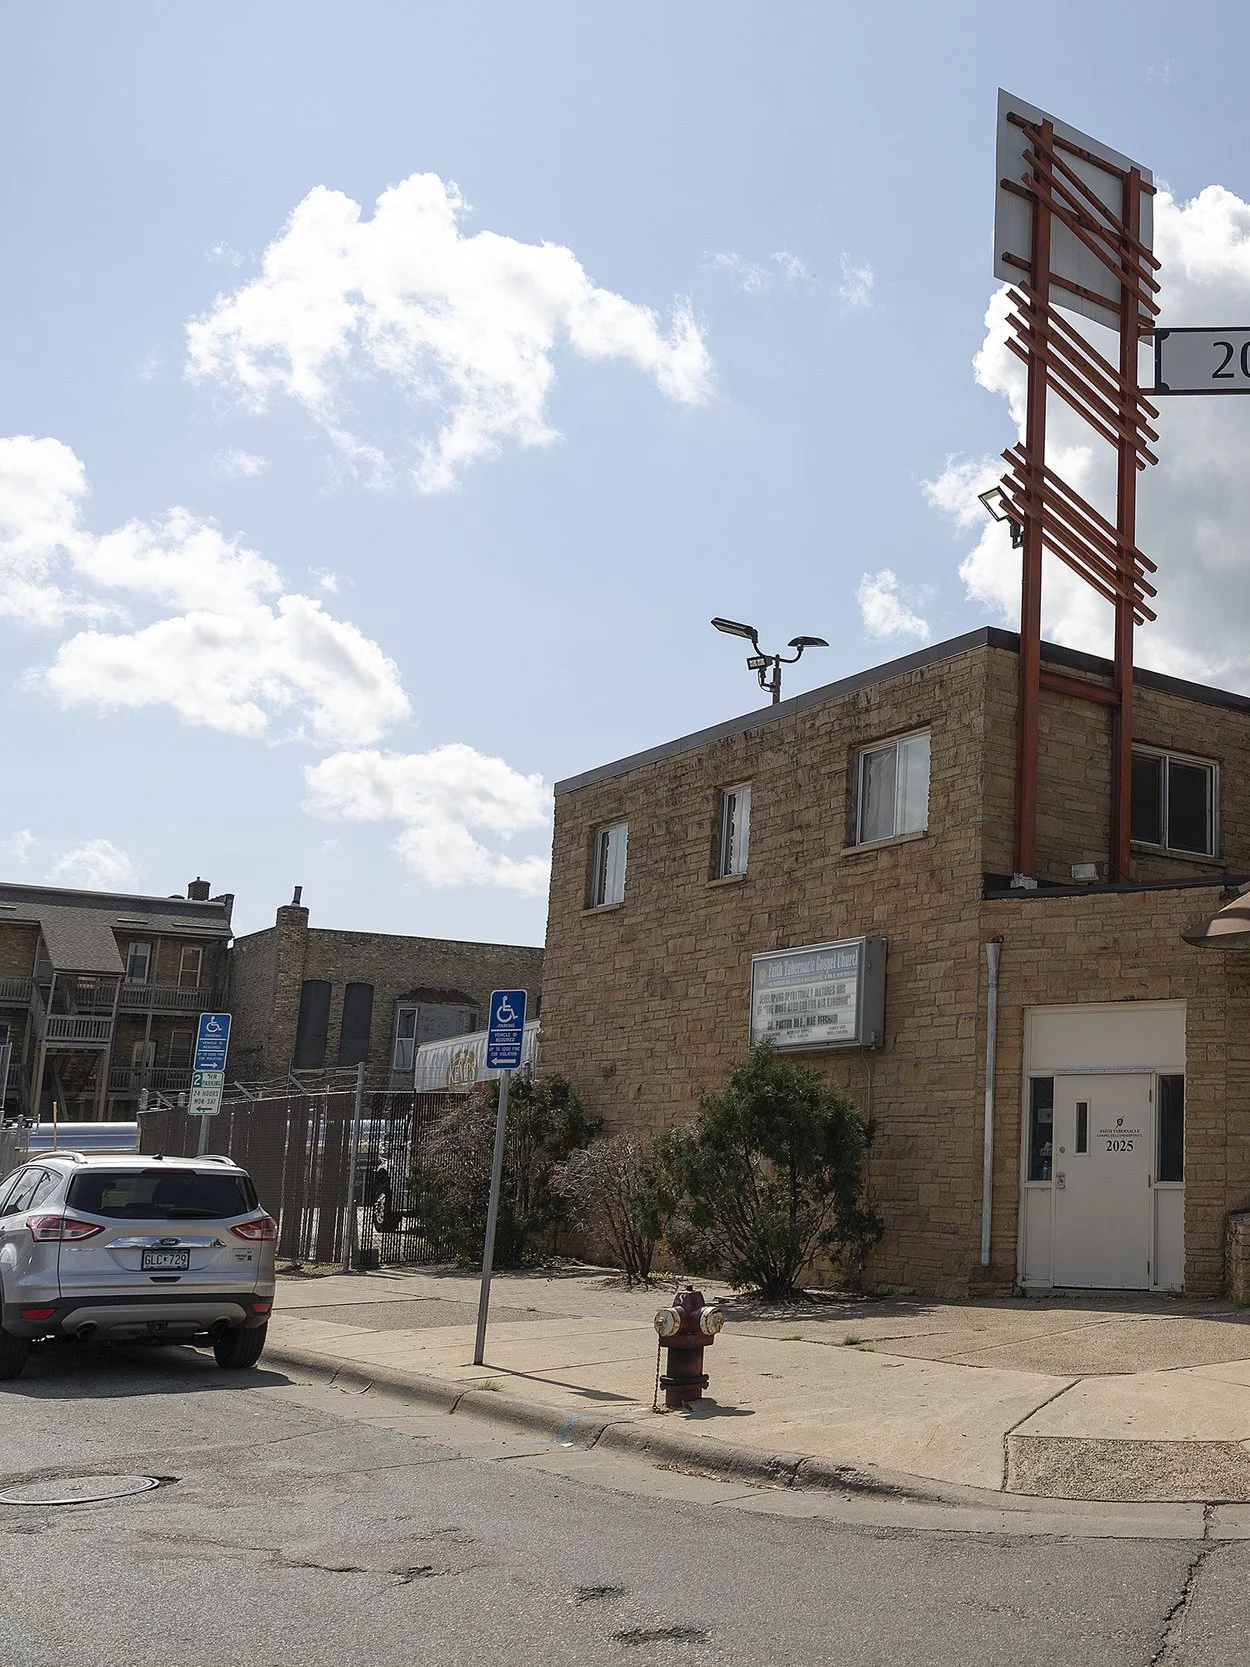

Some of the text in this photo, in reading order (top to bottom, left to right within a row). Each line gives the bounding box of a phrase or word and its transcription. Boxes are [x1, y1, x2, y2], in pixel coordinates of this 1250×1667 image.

[194, 1074, 202, 1086] 2
[1106, 1140, 1134, 1152] 2025
[145, 1254, 187, 1265] GLC 729
